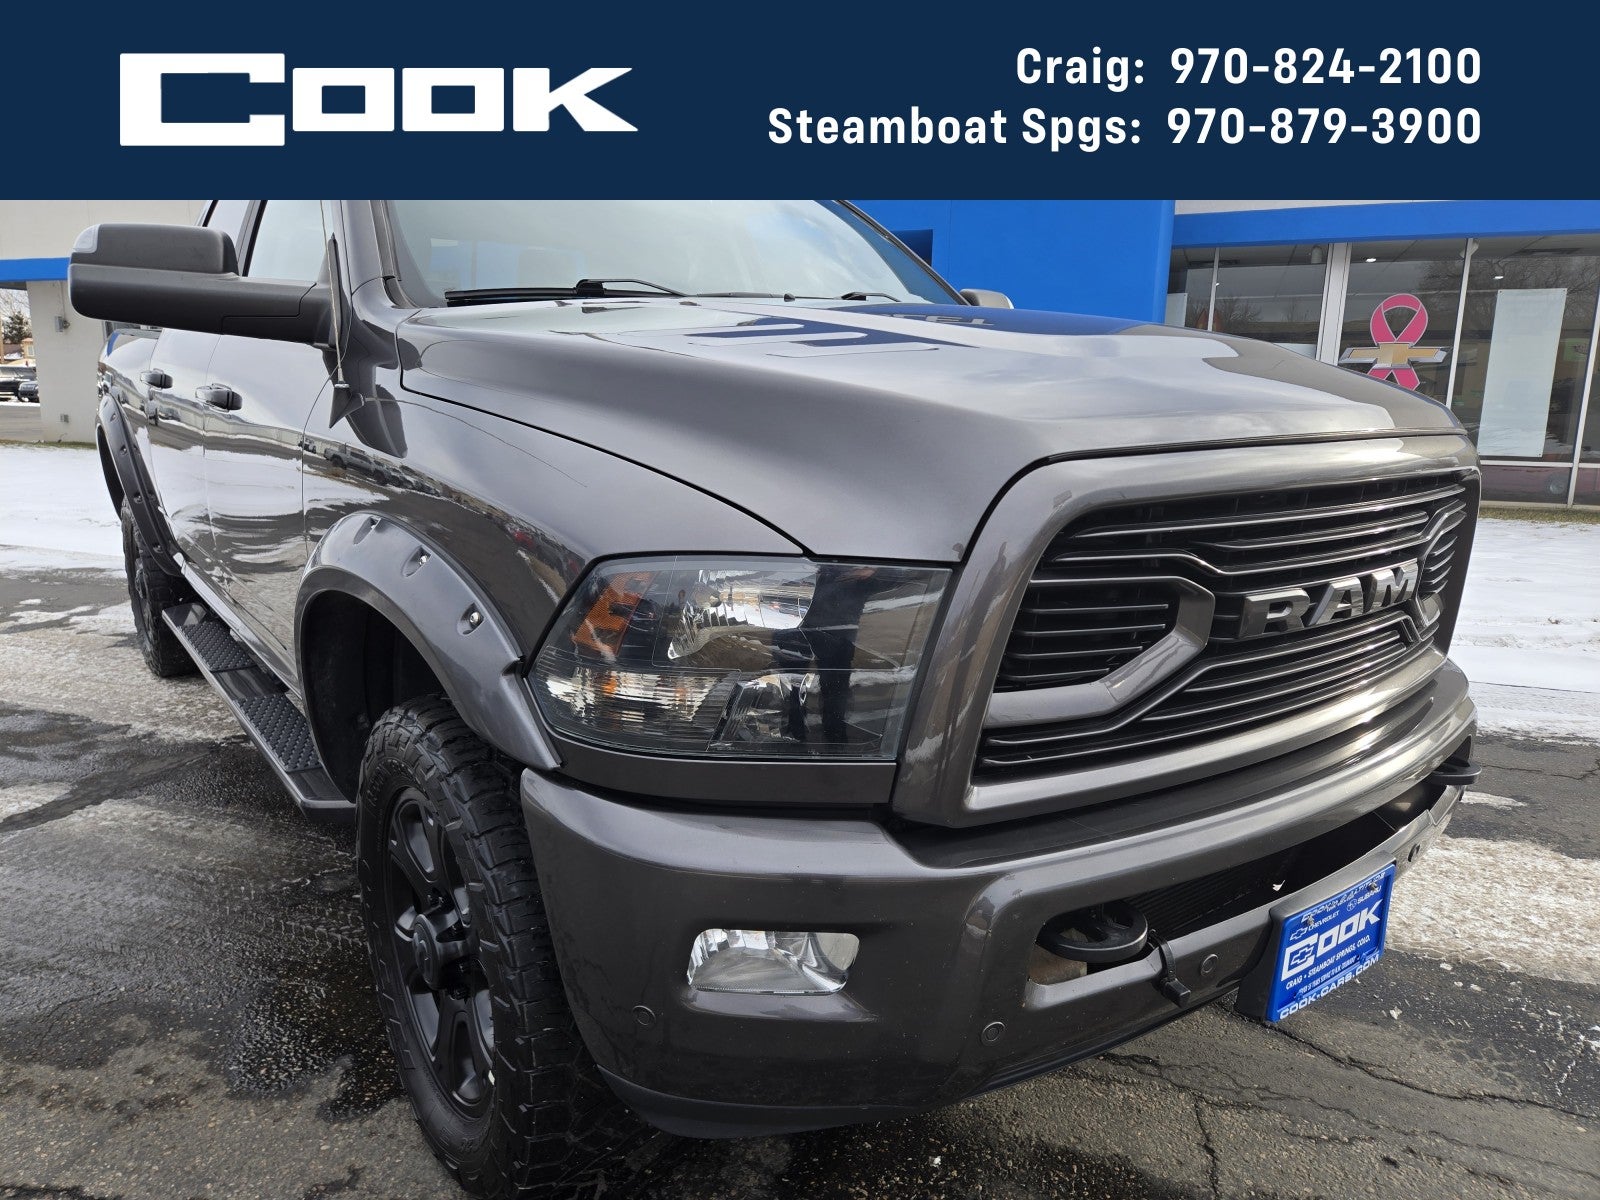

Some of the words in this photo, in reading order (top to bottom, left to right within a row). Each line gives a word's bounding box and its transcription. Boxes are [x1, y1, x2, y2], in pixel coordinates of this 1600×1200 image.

[1239, 560, 1419, 639] RAM
[1281, 899, 1383, 981] COOK
[1285, 975, 1303, 990] CRAIG
